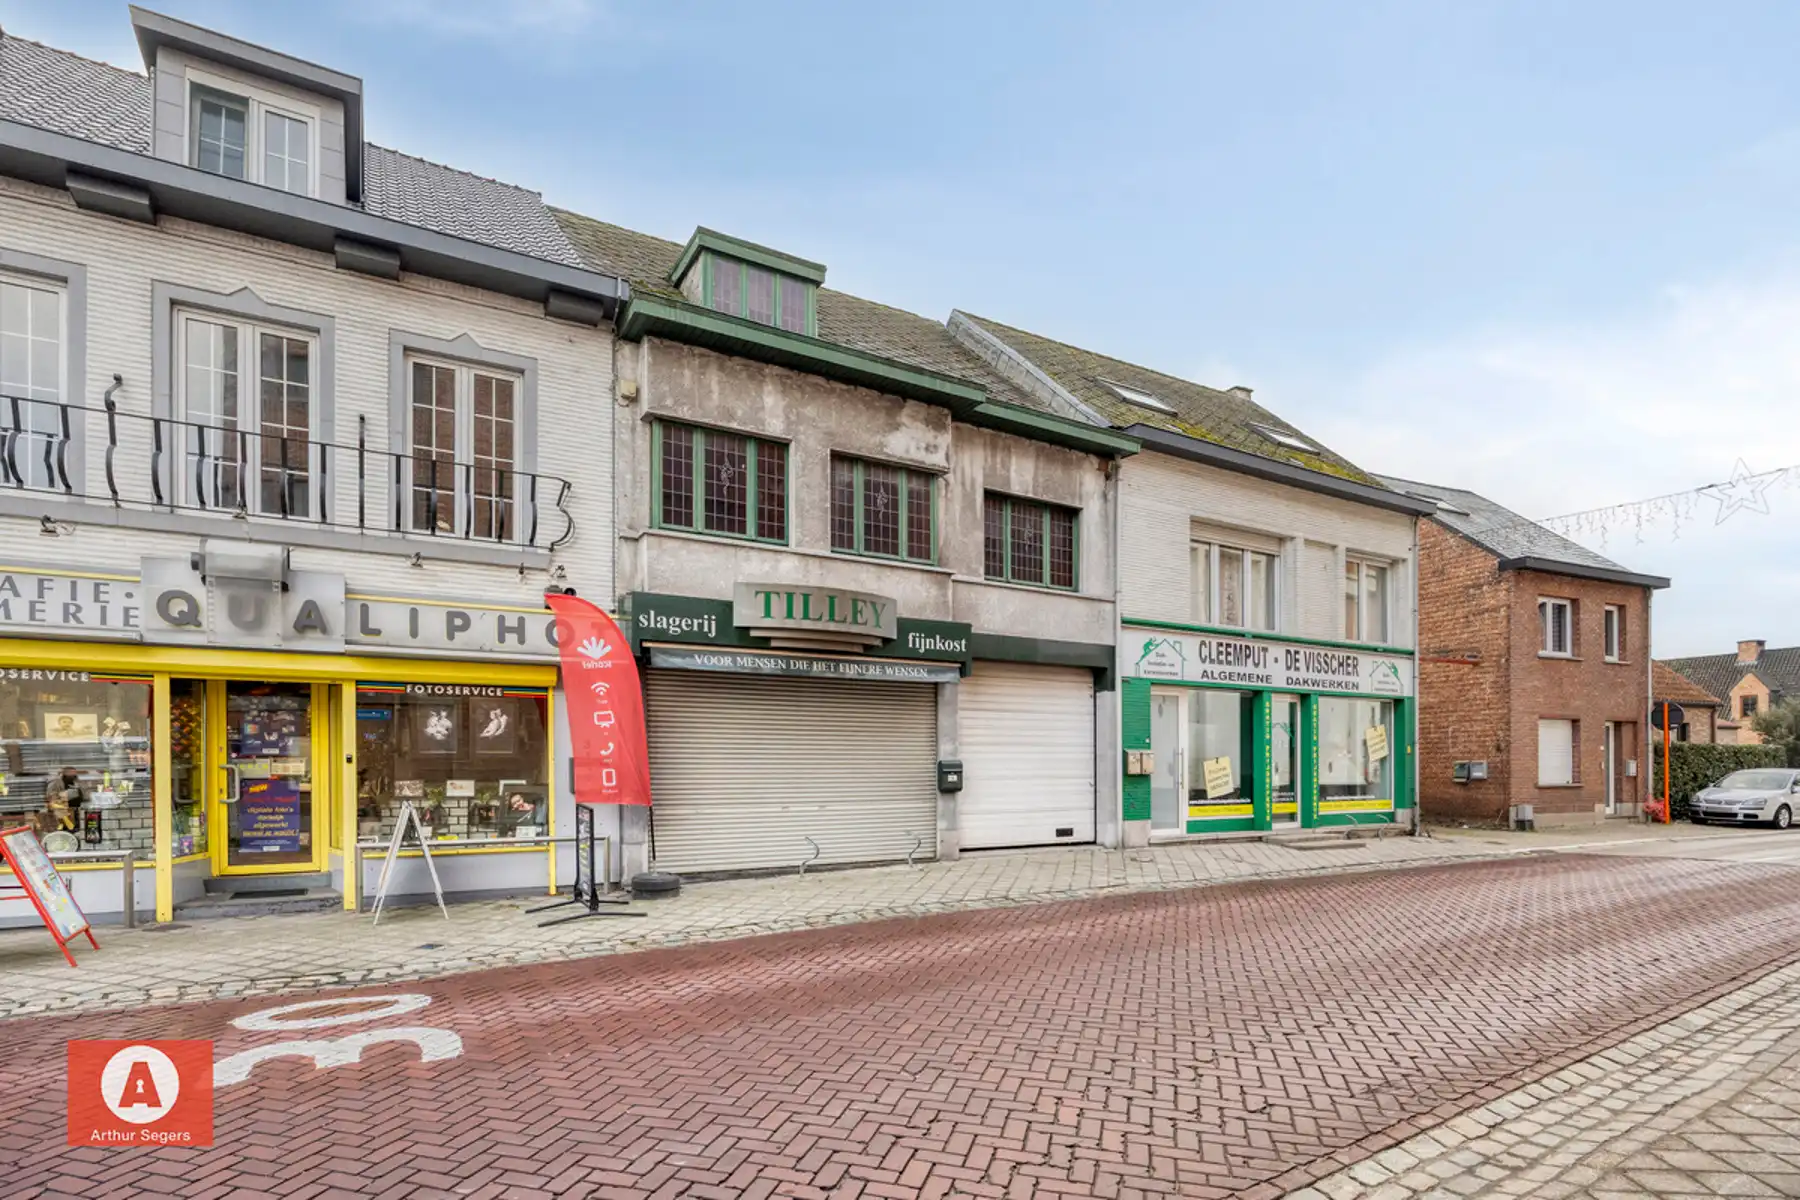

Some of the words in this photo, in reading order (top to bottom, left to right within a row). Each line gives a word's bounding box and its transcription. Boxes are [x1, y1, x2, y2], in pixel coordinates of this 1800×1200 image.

[754, 591, 886, 629] TILLEY
[638, 610, 716, 638] slagerij
[908, 632, 967, 653] fijnkost
[693, 653, 733, 666] VOOR
[736, 656, 786, 669] MENSEN
[790, 659, 811, 671] DIE
[813, 660, 836, 672] HET
[884, 665, 929, 678] WENSEN
[1198, 640, 1268, 669] CLEEMPUT
[1285, 649, 1300, 672] DE
[1304, 651, 1359, 677] VISSCHER
[406, 683, 503, 697] FOTOSERVICE
[1201, 670, 1272, 685] ALGEMENE
[1286, 676, 1359, 691] DAKWERKEN
